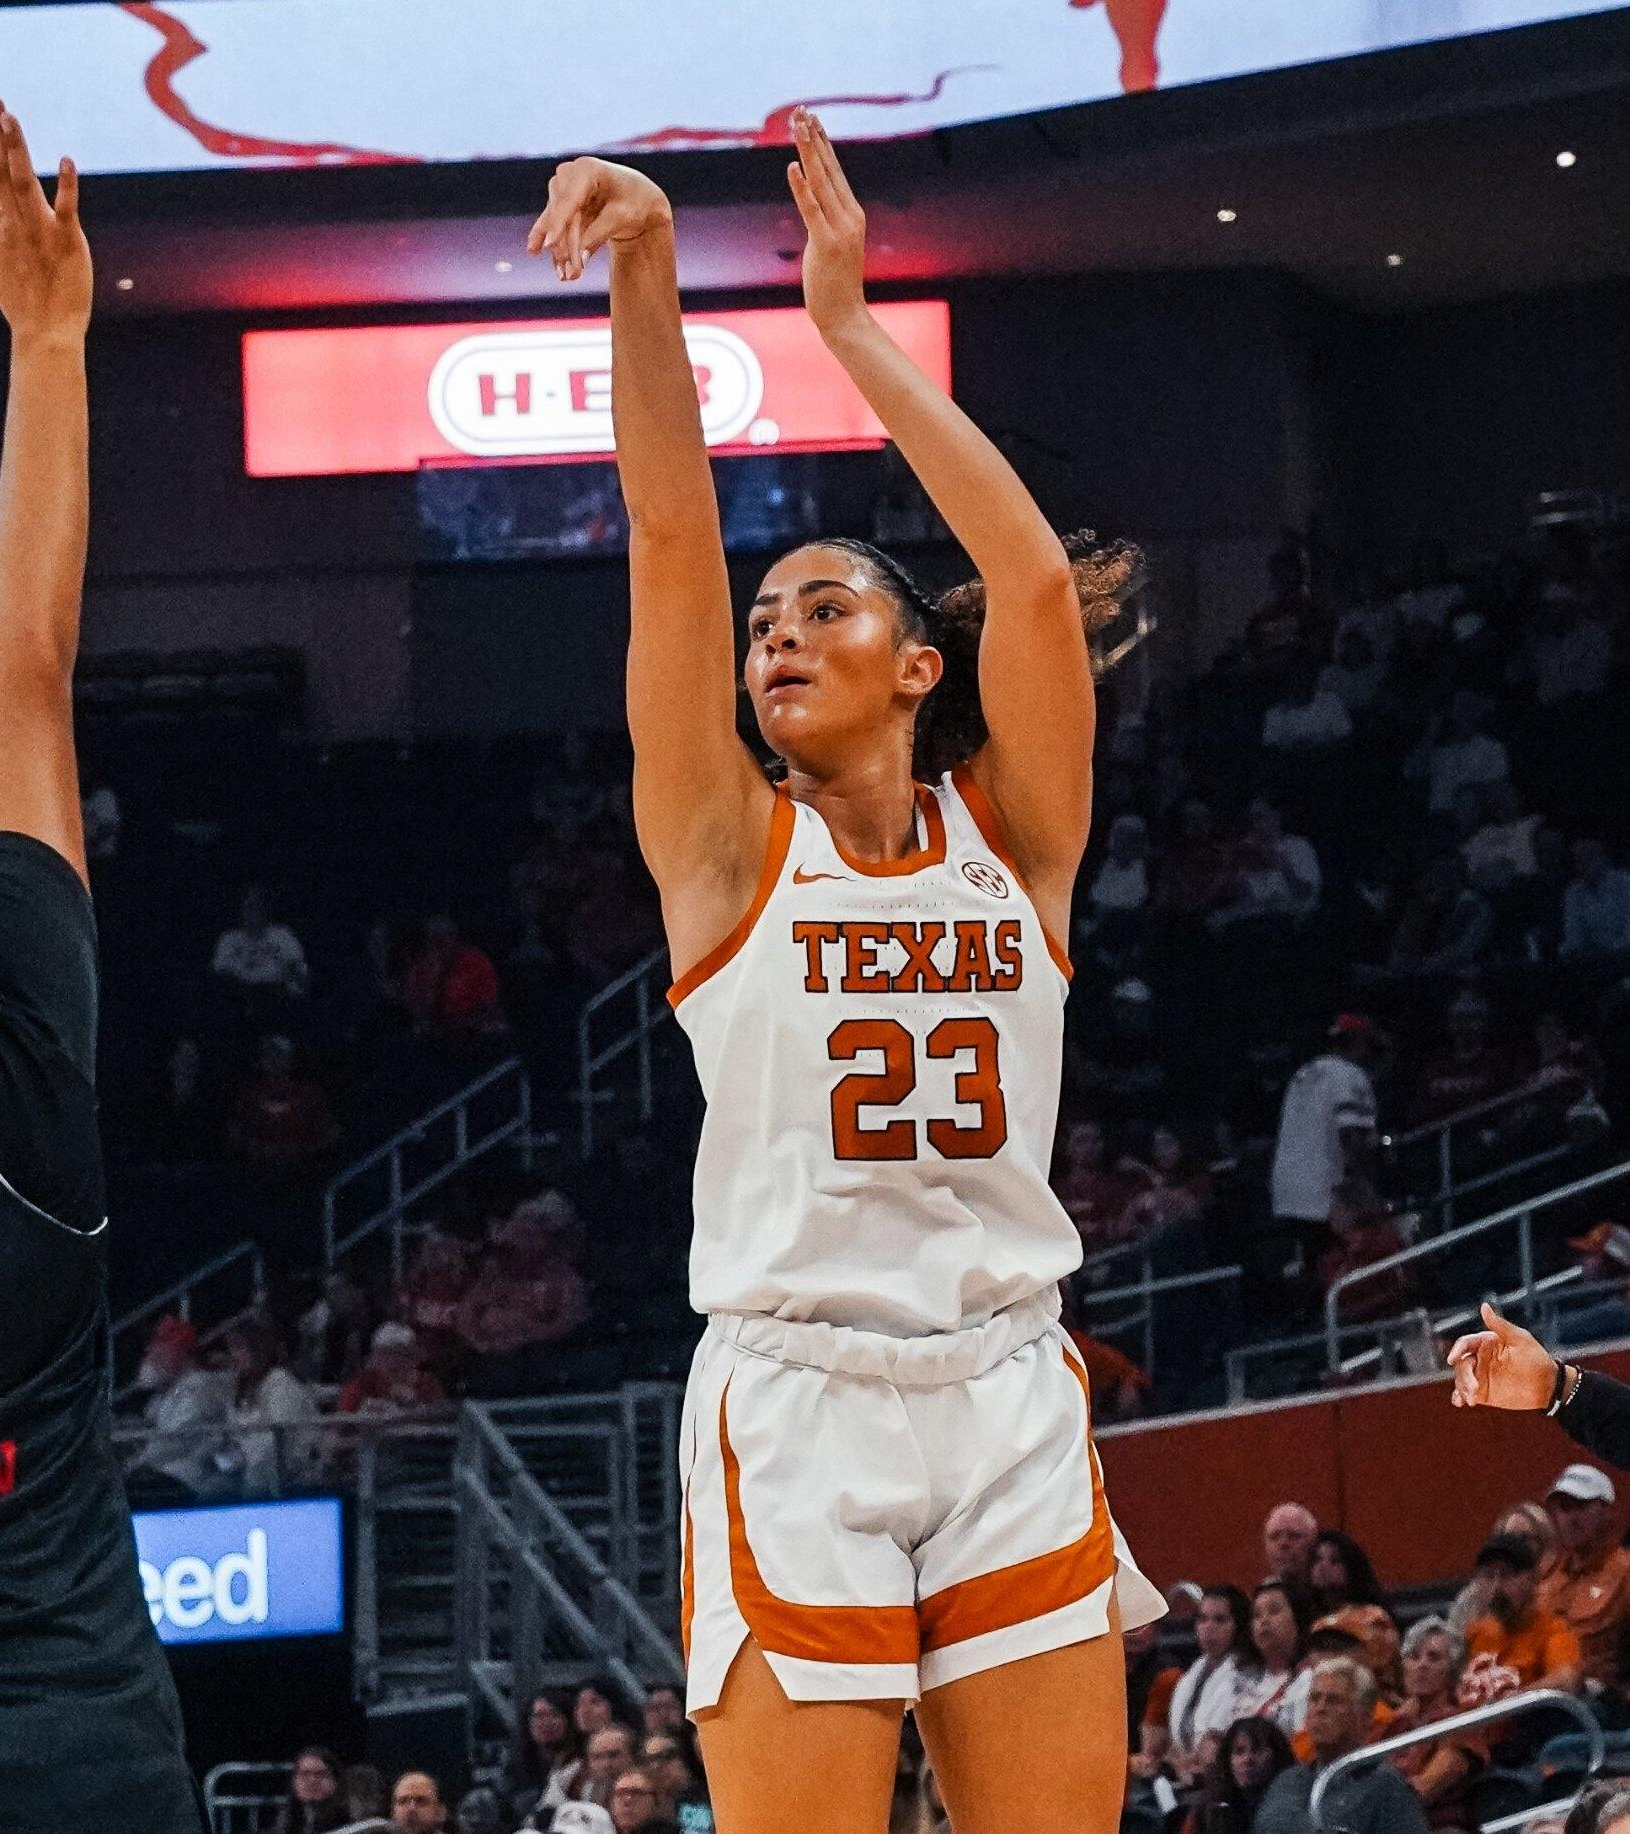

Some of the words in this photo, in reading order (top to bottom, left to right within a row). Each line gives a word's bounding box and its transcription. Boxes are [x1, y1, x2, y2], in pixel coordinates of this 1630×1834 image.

[478, 366, 713, 416] H-E
[793, 919, 1023, 993] TEXAS
[827, 1016, 1007, 1160] 23
